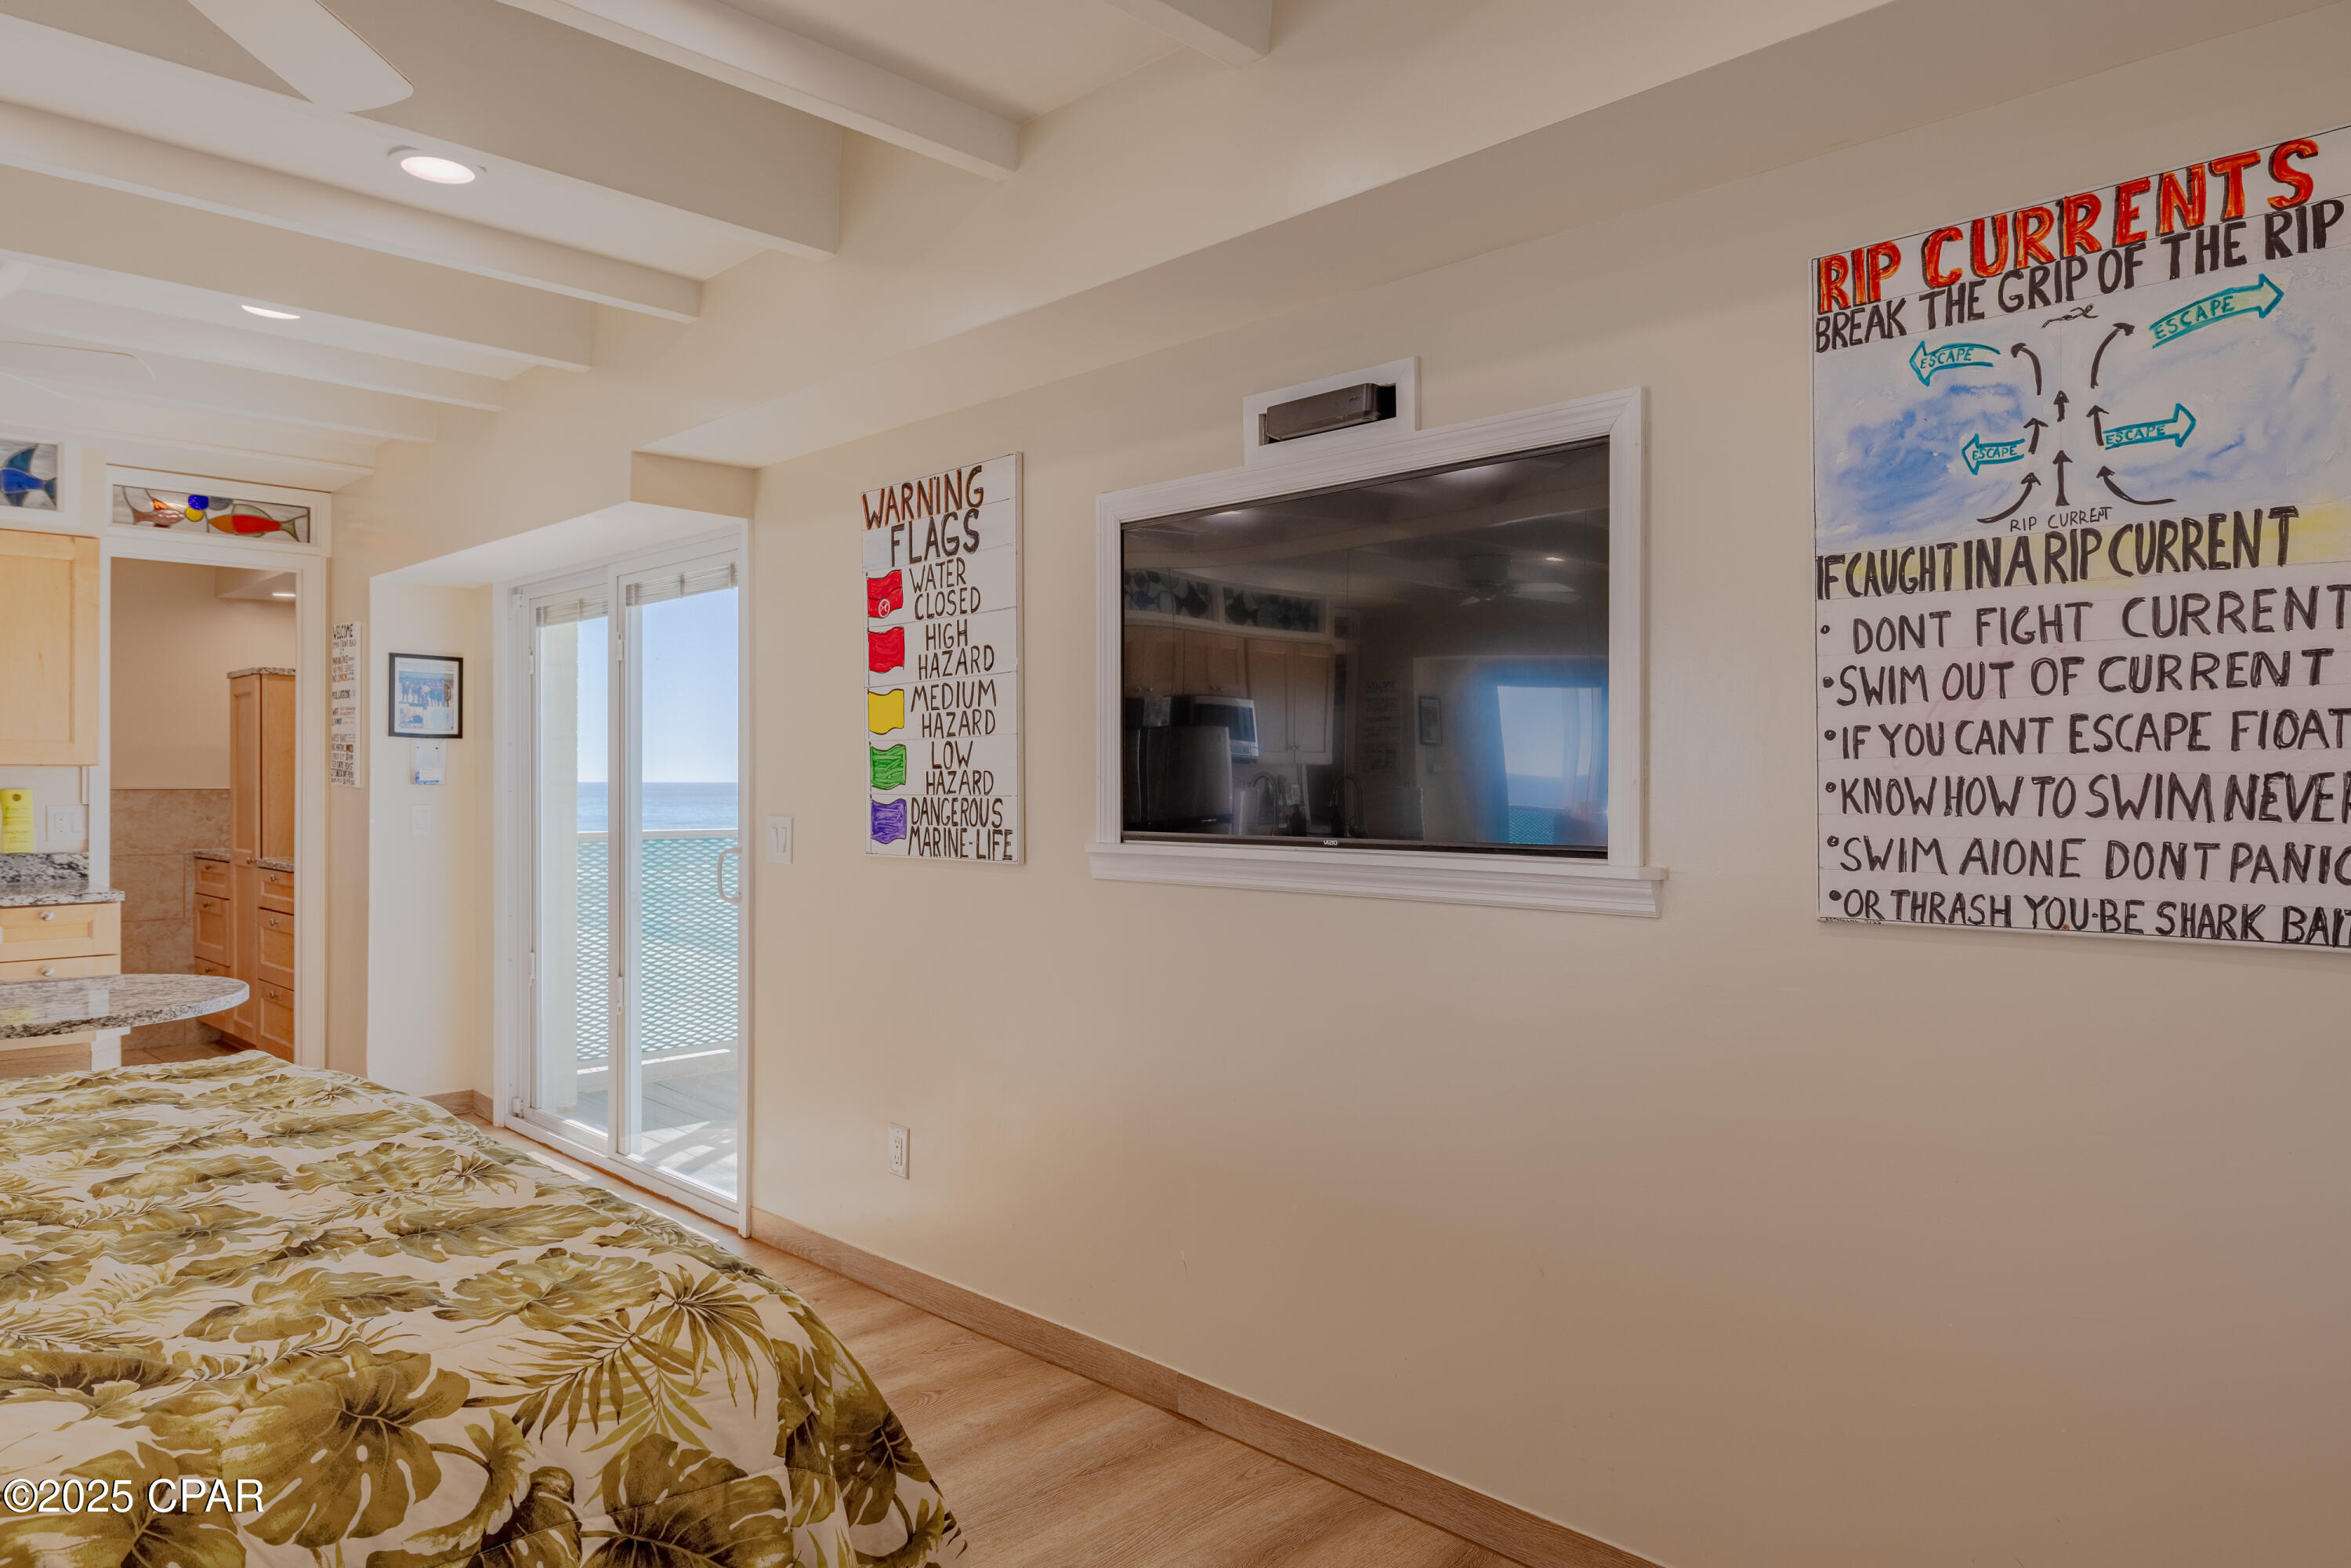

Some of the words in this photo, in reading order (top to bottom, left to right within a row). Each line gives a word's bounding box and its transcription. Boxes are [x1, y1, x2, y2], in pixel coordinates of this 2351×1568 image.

[1818, 241, 1901, 313] RIP
[1921, 138, 2319, 288] CURRENTS
[1815, 298, 1907, 353] BREAK
[1919, 277, 1985, 330] THE
[1998, 255, 2088, 313] GRIP
[2098, 241, 2146, 294] OF
[2160, 220, 2247, 280] THE
[2265, 199, 2345, 259] RIP
[2154, 295, 2235, 341] ESCAPE
[1919, 345, 1974, 370] ESCAPE
[1971, 444, 2019, 461] ESCAPE
[2104, 424, 2166, 445] ESCAPE
[862, 465, 984, 531] WARNING
[2009, 515, 2038, 532] RIP
[2048, 505, 2114, 530] CURRENT
[891, 508, 980, 567] FLAGS
[1817, 554, 1846, 600] IF
[1846, 542, 1958, 597] CAUGHT
[1964, 537, 2001, 590] IN
[2004, 535, 2037, 586] A
[2044, 528, 2103, 585] RIP
[2108, 506, 2299, 578] CURRENT
[909, 556, 966, 593] WATER
[915, 586, 980, 621] CLOSED
[1853, 610, 1951, 654] DONT
[1976, 602, 2093, 646] FIGHT
[2122, 585, 2351, 638] CURRENT
[332, 624, 353, 639] WELCOME
[926, 618, 969, 651] HIGH
[918, 644, 994, 680] HAZARD
[1836, 664, 1930, 707] SWIM
[1942, 660, 2015, 701] OUT
[2030, 657, 2085, 696] OF
[2098, 648, 2335, 693] CURRENT
[911, 679, 997, 712] MEDIUM
[922, 708, 996, 739] HAZARD
[1842, 726, 1871, 759] IF
[1878, 720, 1945, 758] YOU
[1955, 716, 2054, 755] CANT
[2069, 712, 2212, 753] ESCAPE
[931, 741, 973, 770] LOW
[926, 770, 994, 795] HAZARD
[1841, 777, 1935, 817] KNOW
[1944, 775, 2024, 817] HOW
[2031, 776, 2077, 819] TO
[2085, 772, 2215, 824] SWIM
[911, 796, 1004, 829] DANGEROUS
[1839, 835, 1948, 875] SWIM
[2105, 840, 2221, 880] DONT
[2230, 842, 2351, 885] PANIC
[1844, 889, 1886, 921] OR
[1890, 889, 2012, 928] THRASH
[2155, 900, 2267, 941] SHARK
